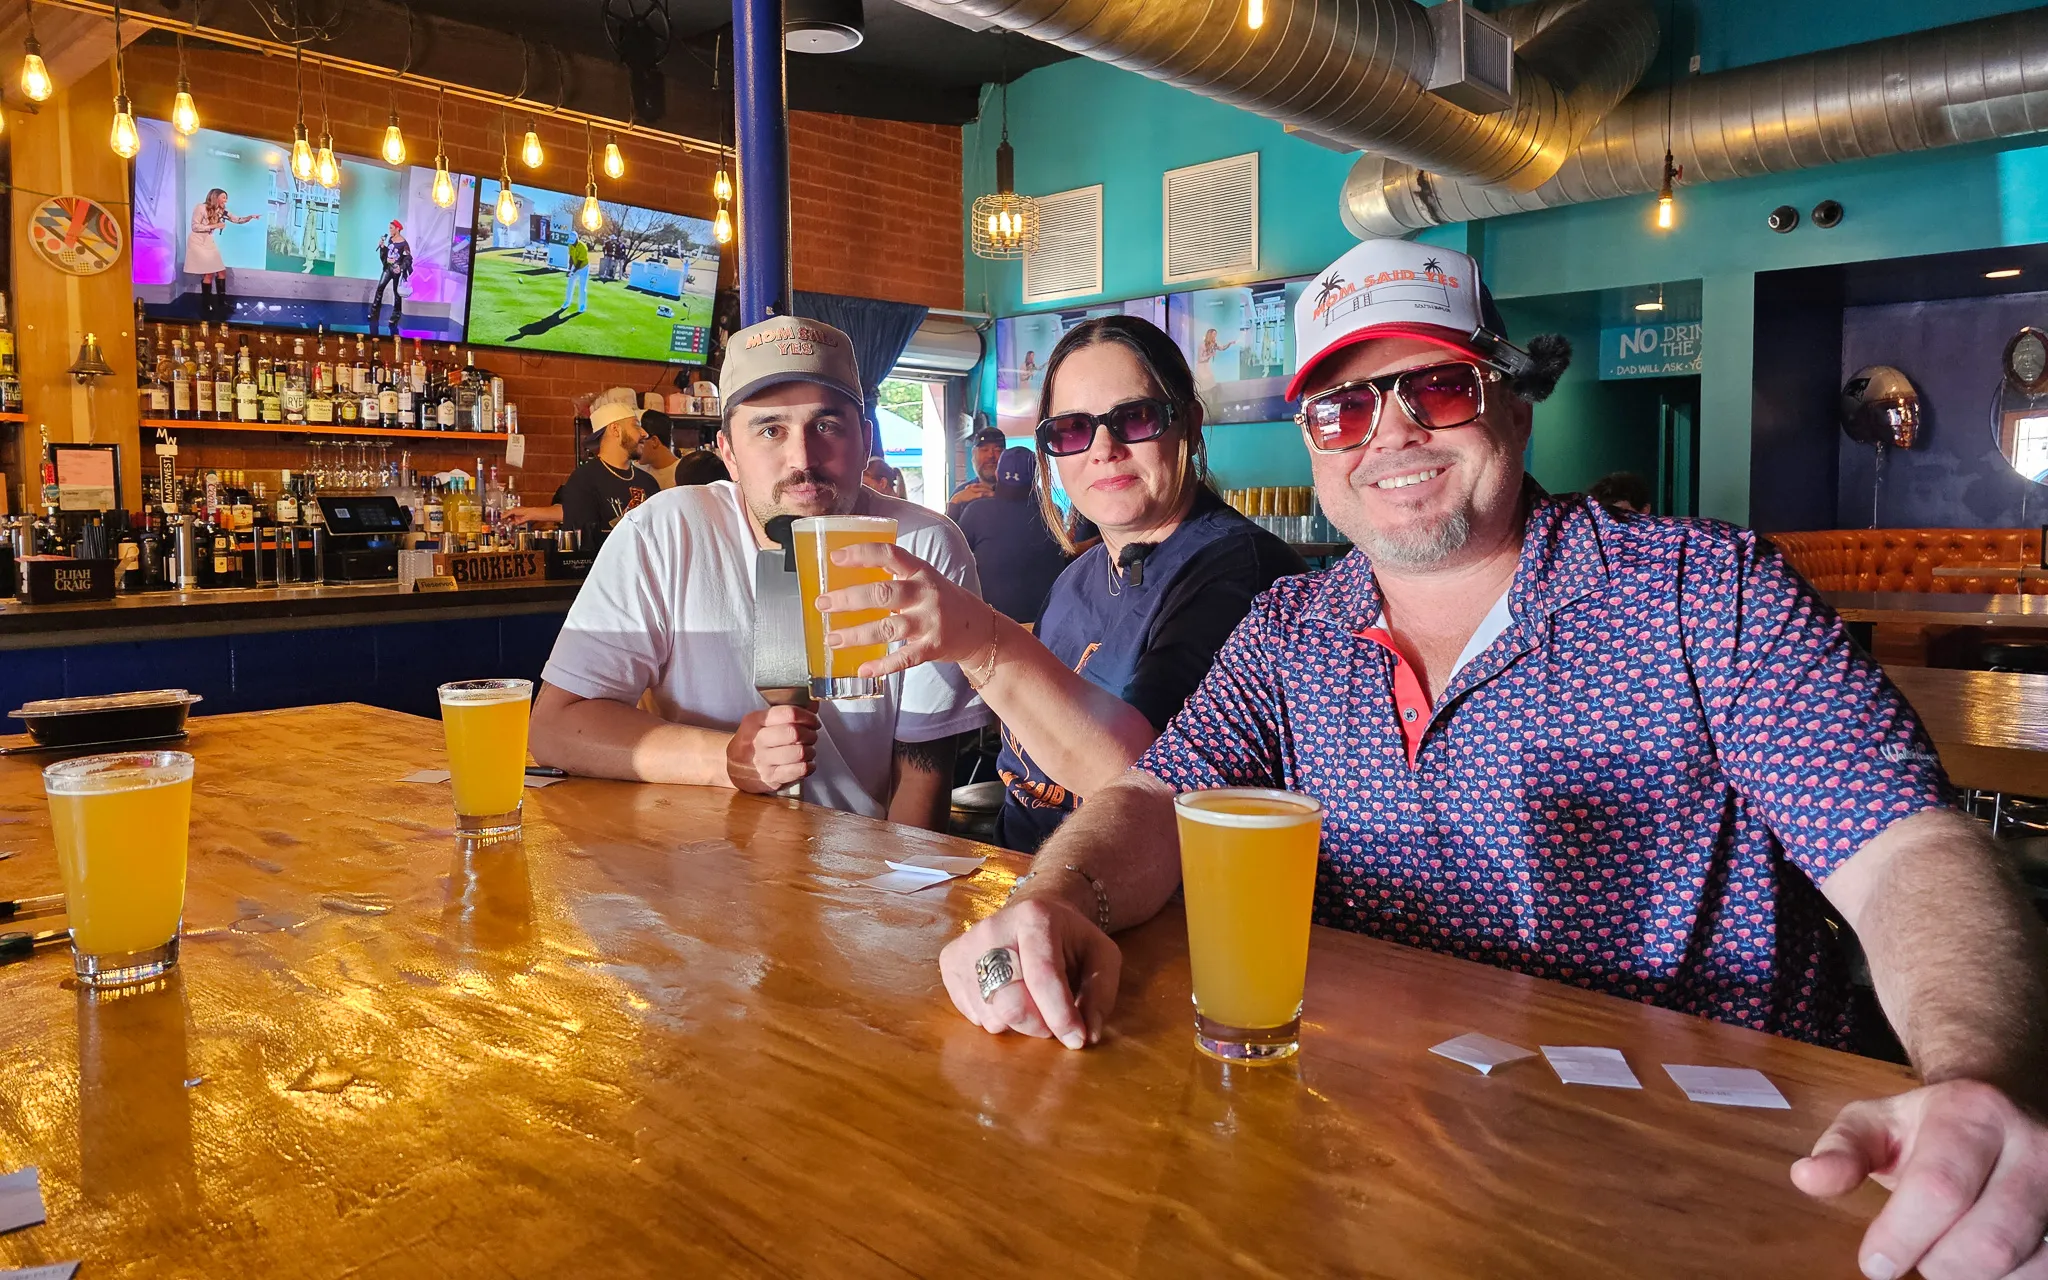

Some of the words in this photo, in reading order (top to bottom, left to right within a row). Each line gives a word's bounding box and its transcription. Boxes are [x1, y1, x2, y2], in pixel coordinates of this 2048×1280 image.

[1313, 282, 1358, 322] MOM
[1364, 269, 1415, 289] SAID
[1425, 271, 1459, 289] YES
[745, 326, 796, 350] MOM
[1619, 328, 1658, 359] NO
[775, 341, 814, 356] YES
[1660, 340, 1694, 357] THE
[1616, 365, 1638, 376] DAD
[1638, 364, 1660, 374] WILL
[1662, 362, 1683, 373] ASK
[287, 394, 303, 408] RYE
[164, 458, 173, 503] MADEWEST
[55, 568, 91, 581] ELIJAH
[451, 553, 537, 583] BOOKER'S
[54, 578, 92, 592] CRAIG
[420, 580, 454, 588] Reserved
